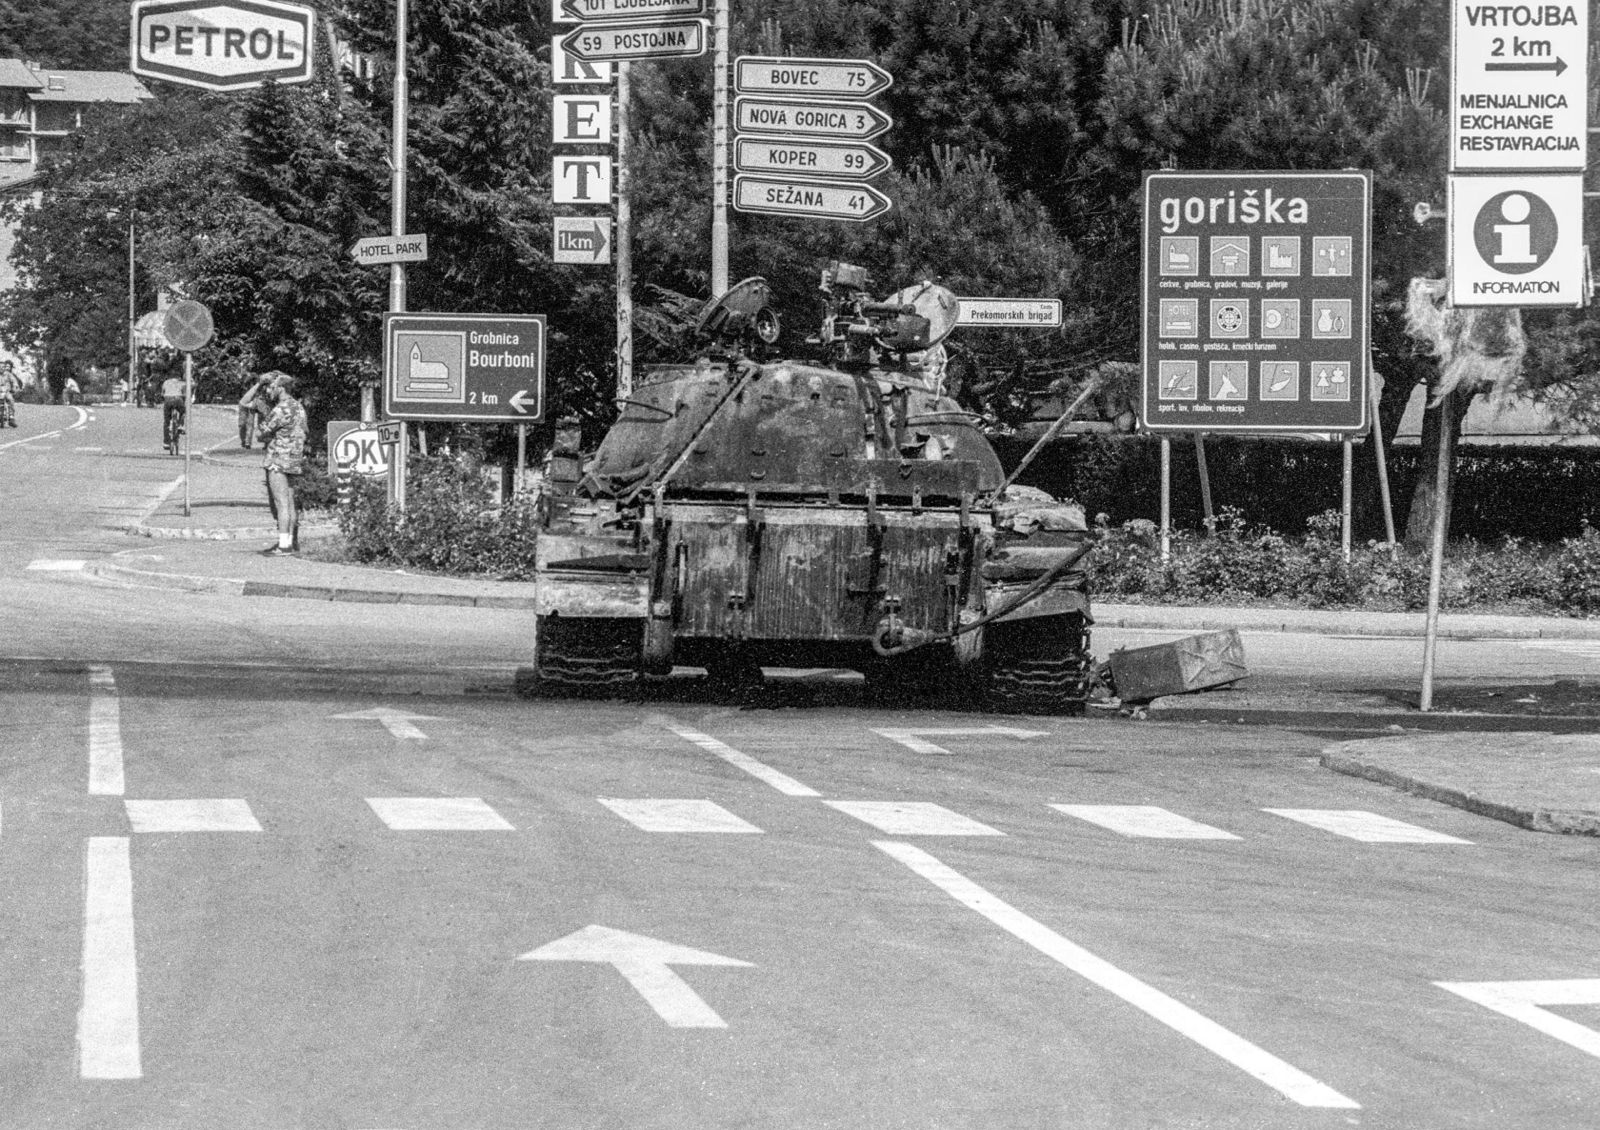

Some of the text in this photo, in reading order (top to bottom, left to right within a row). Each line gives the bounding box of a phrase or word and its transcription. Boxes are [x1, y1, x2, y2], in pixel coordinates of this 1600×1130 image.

[614, 0, 690, 9] LJUBL
[1465, 5, 1578, 27] VRTOJBA
[150, 25, 294, 60] PETROL
[583, 31, 686, 51] 59 POSTOJNA
[1491, 36, 1552, 57] 2 km
[771, 70, 866, 87] BOVEC 75
[561, 11, 604, 200] KET
[1460, 94, 1568, 109] MENJALNICA
[750, 109, 866, 129] NOVA GORICA 3
[1460, 114, 1554, 130] EXCHANGE
[1459, 136, 1580, 151] RESTAVRACIJA
[769, 149, 865, 169] KOPER 99
[766, 186, 865, 210] SEŽANA 41
[1160, 188, 1309, 233] goriška
[360, 242, 422, 257] HOTEL PARK
[558, 232, 593, 250] 1km
[1473, 281, 1560, 294] INFORMATION
[971, 310, 1053, 323] Prekomorskih brigad
[470, 331, 519, 345] Grobnica
[469, 350, 535, 368] Bourboni
[469, 392, 498, 404] 2 km
